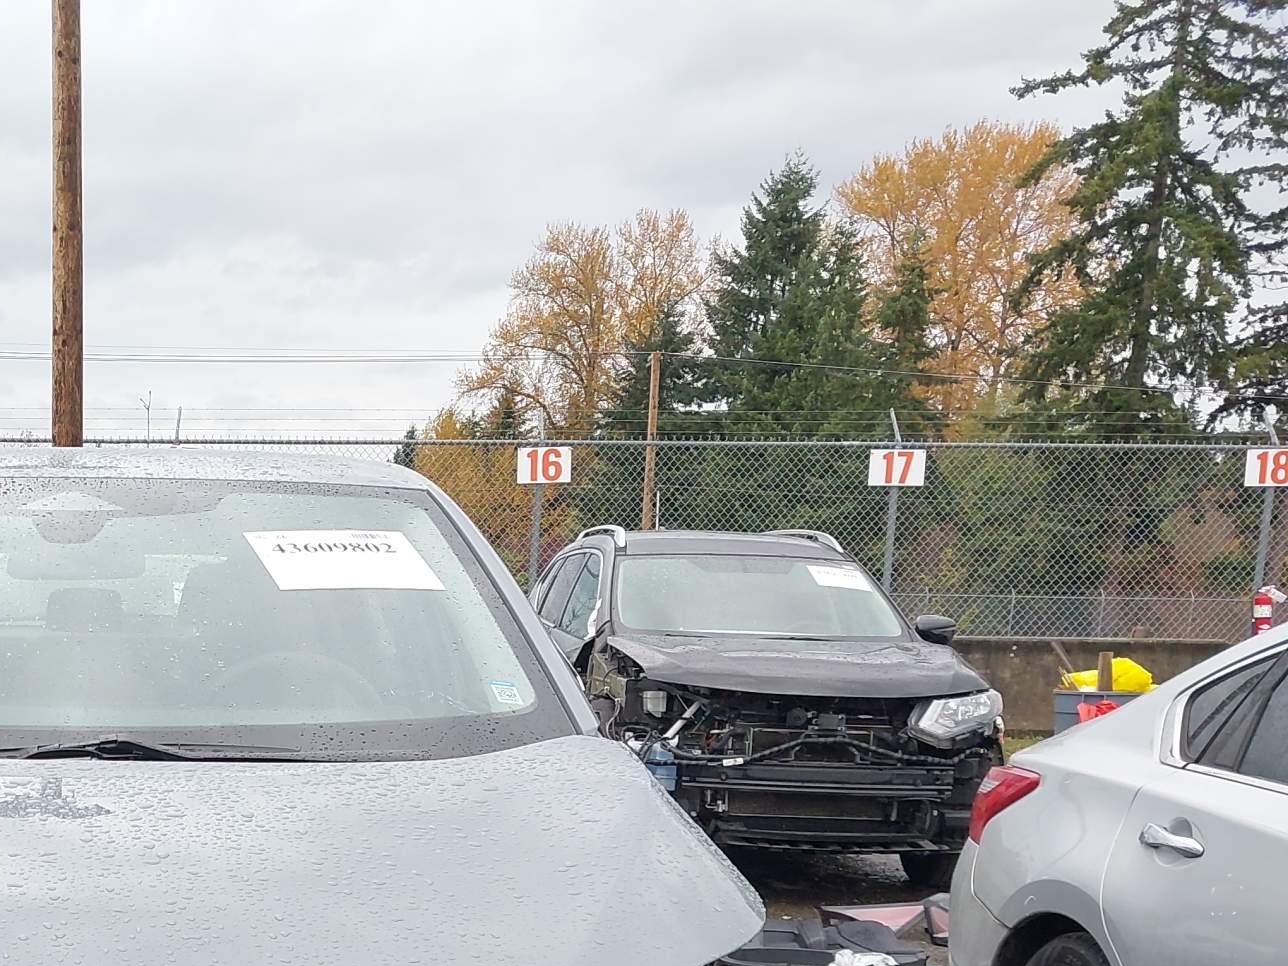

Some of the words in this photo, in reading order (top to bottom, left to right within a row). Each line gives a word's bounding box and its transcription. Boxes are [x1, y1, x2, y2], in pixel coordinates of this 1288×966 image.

[527, 448, 562, 481] 16
[882, 451, 914, 484] 17
[1256, 450, 1288, 485] 18
[271, 542, 397, 554] 43609802
